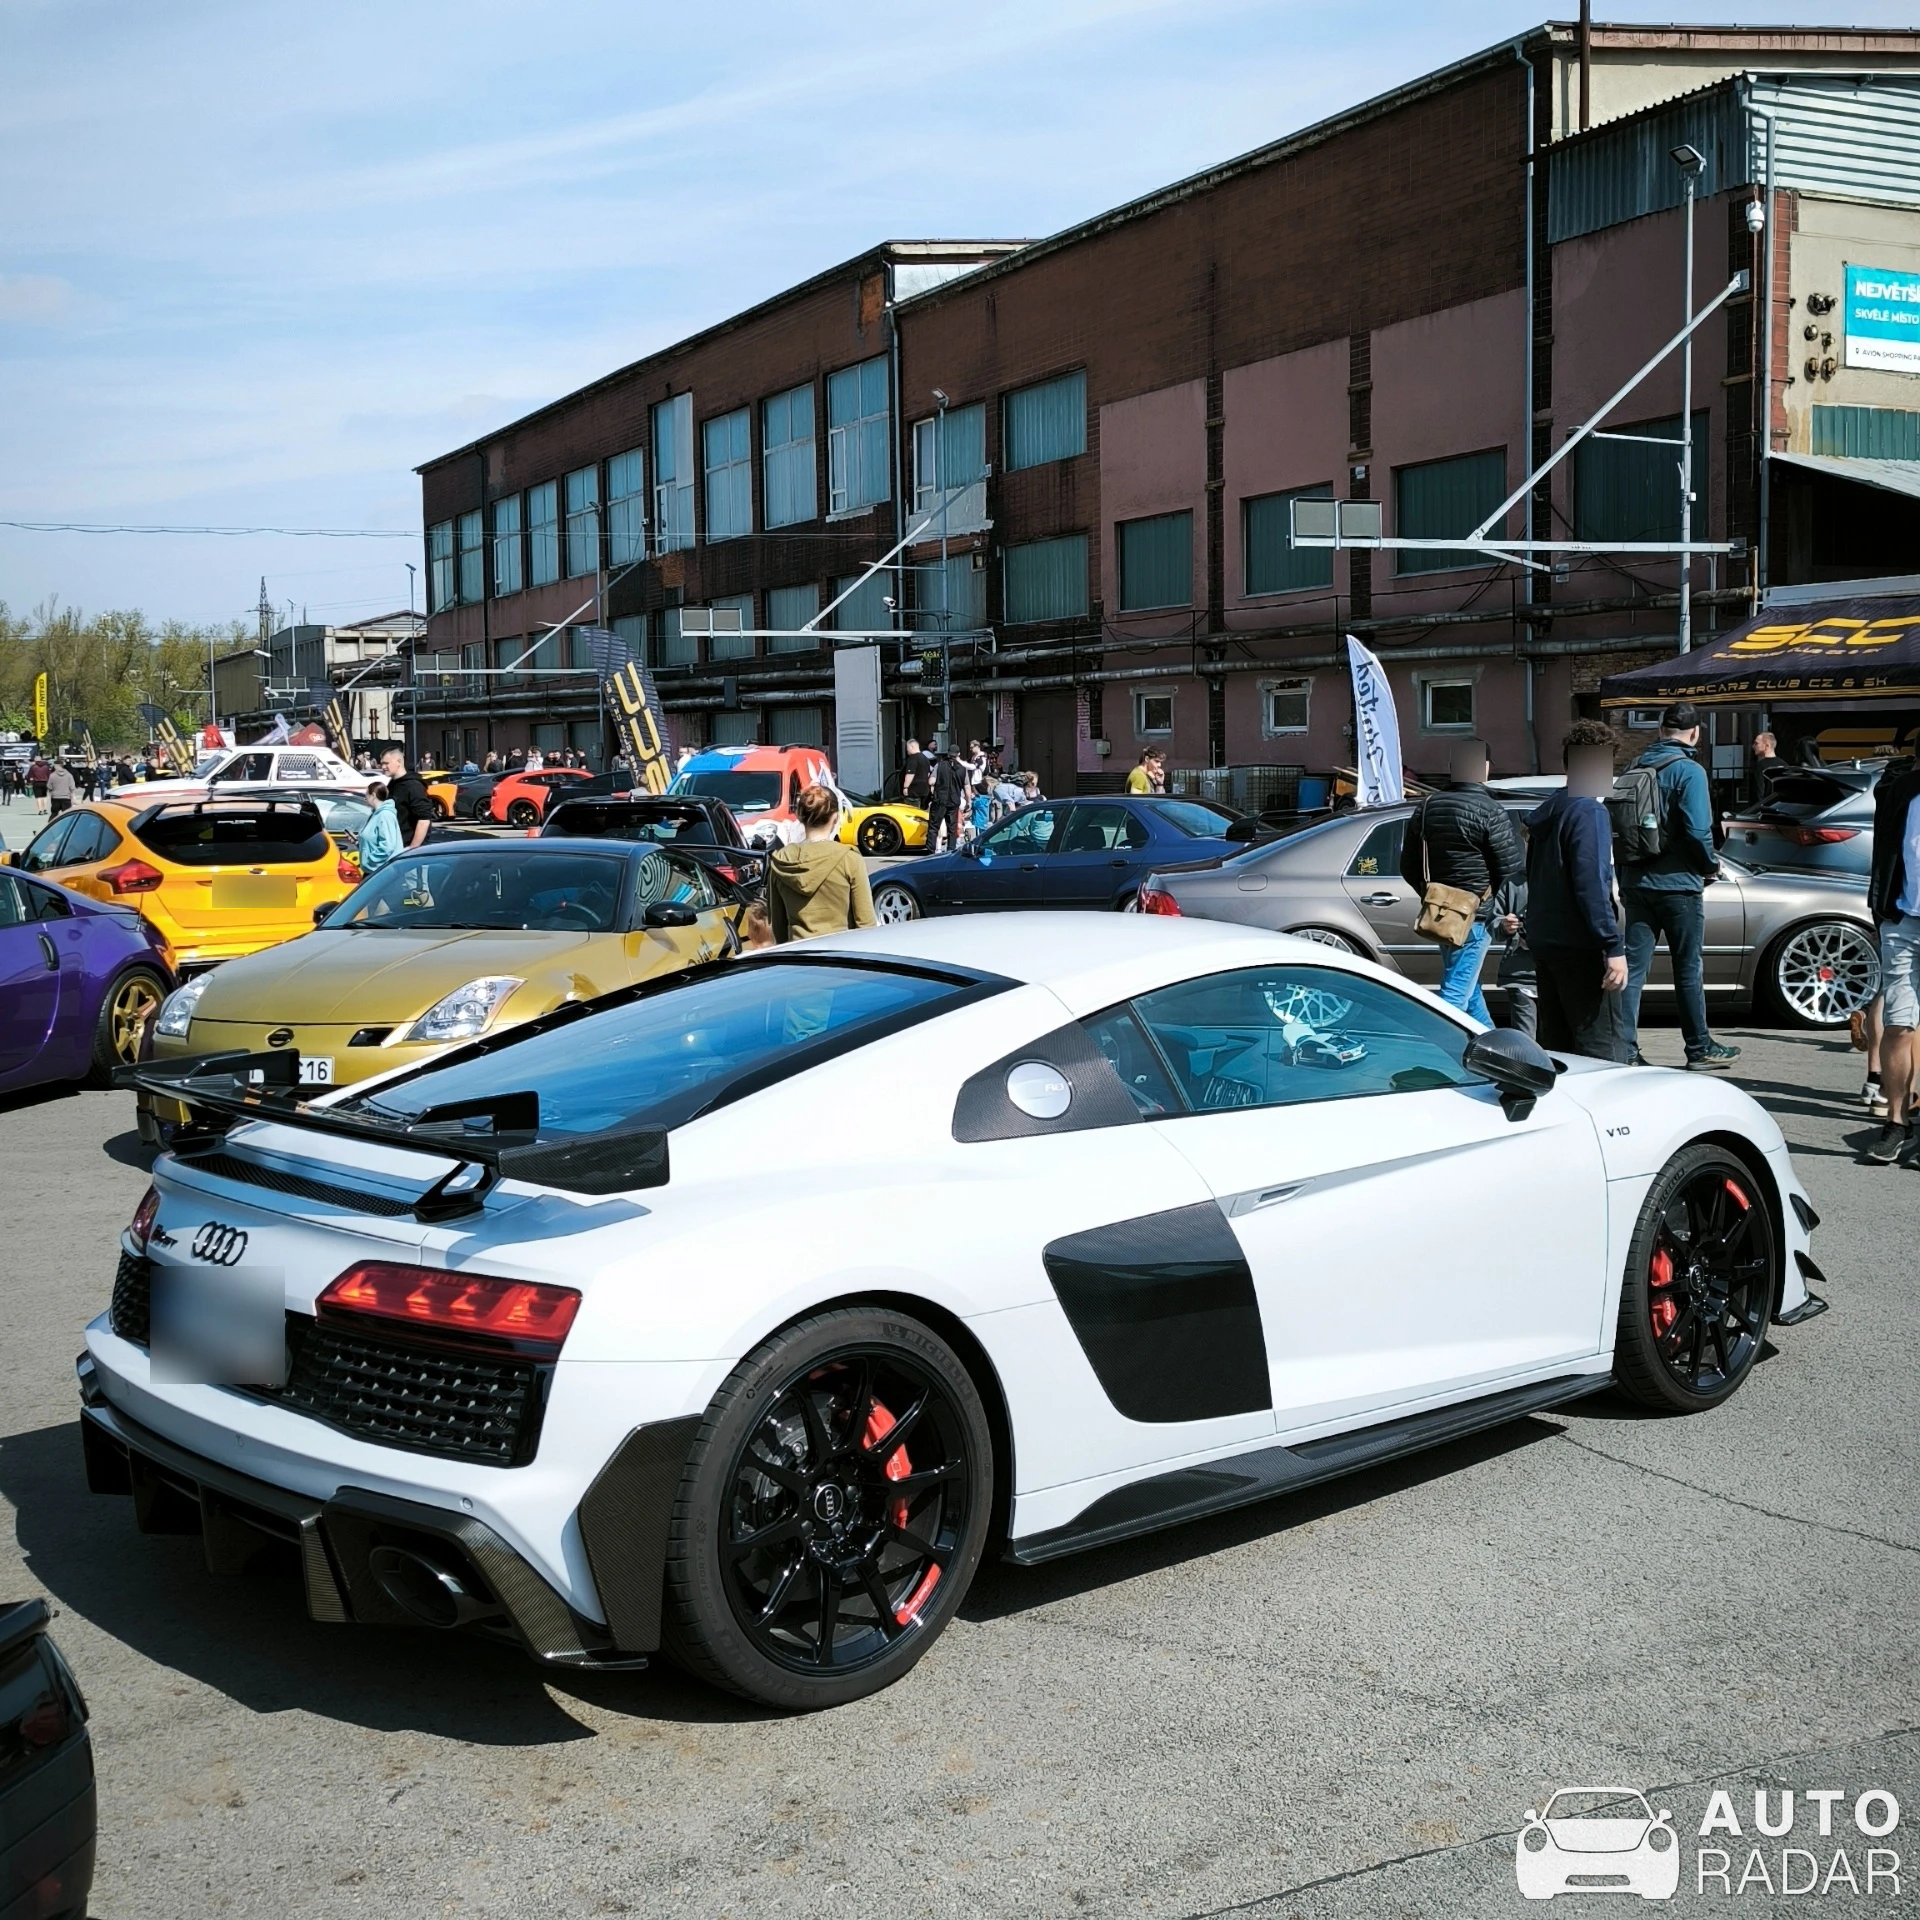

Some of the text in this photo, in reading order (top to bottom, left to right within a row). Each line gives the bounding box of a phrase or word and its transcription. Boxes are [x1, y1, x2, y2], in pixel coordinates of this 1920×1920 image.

[1891, 311, 1919, 324] MÍSTO
[1862, 349, 1880, 357] AVION
[1657, 677, 1888, 696] SUPERCARS CLUB CZ & SK
[1605, 1126, 1630, 1137] V10
[904, 1330, 971, 1396] MICHELIN
